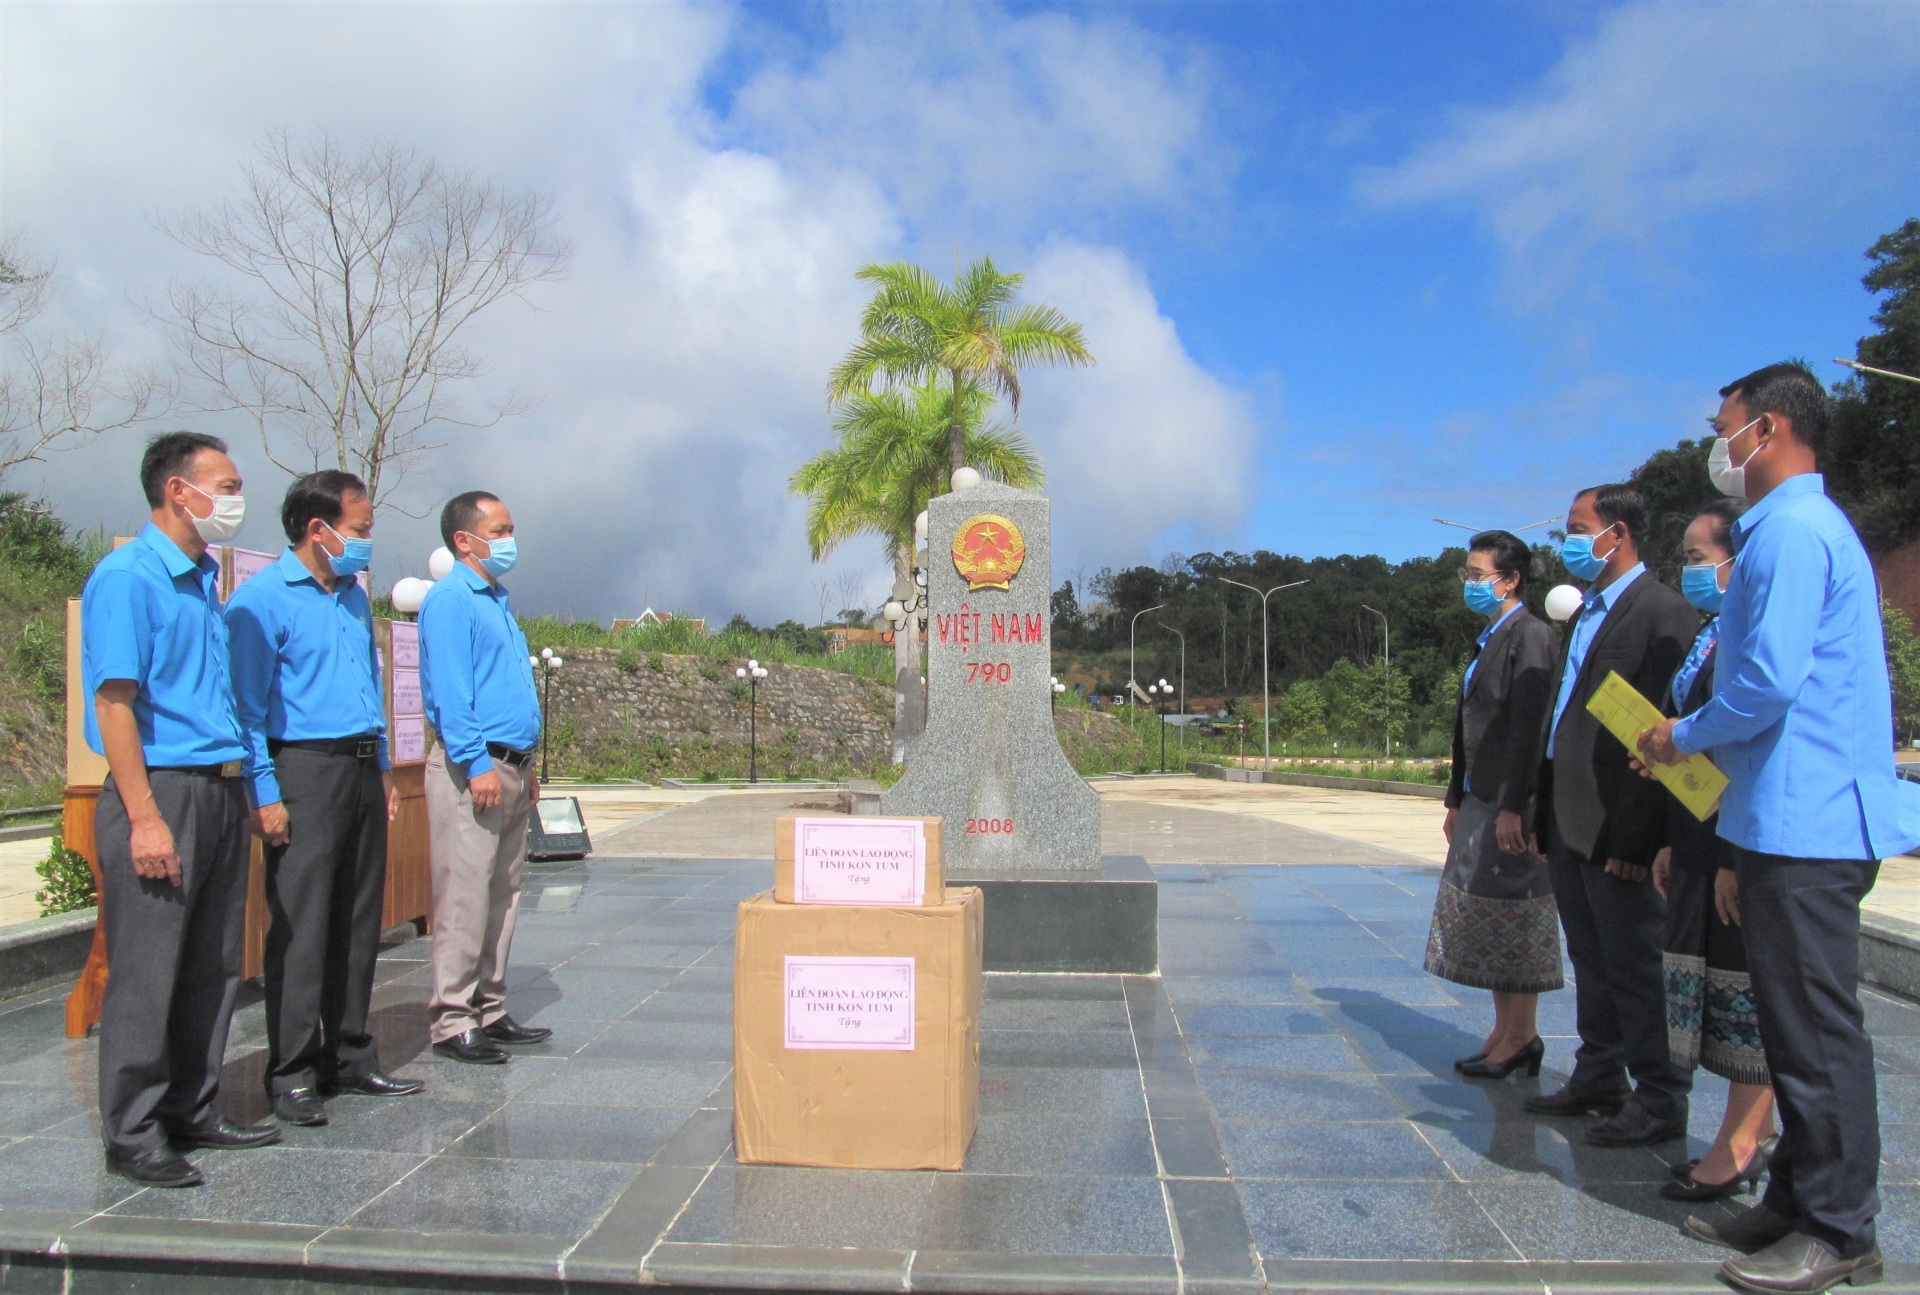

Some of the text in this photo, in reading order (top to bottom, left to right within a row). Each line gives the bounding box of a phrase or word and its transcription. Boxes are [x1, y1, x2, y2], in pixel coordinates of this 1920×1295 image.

[937, 604, 1043, 653] VIỆT NAM
[967, 662, 1012, 685] 790
[966, 818, 1014, 835] 2008
[805, 846, 913, 860] LIÊN ĐOÀN LAO ĐỘNG
[818, 858, 899, 870] TỈNH KON TUM
[847, 874, 870, 885] Tặng
[790, 986, 908, 1001] LIÊN ĐOÀN LAO ĐỘNG
[805, 1000, 893, 1013] TỈNH KON TUM
[838, 1017, 862, 1028] Tặng
